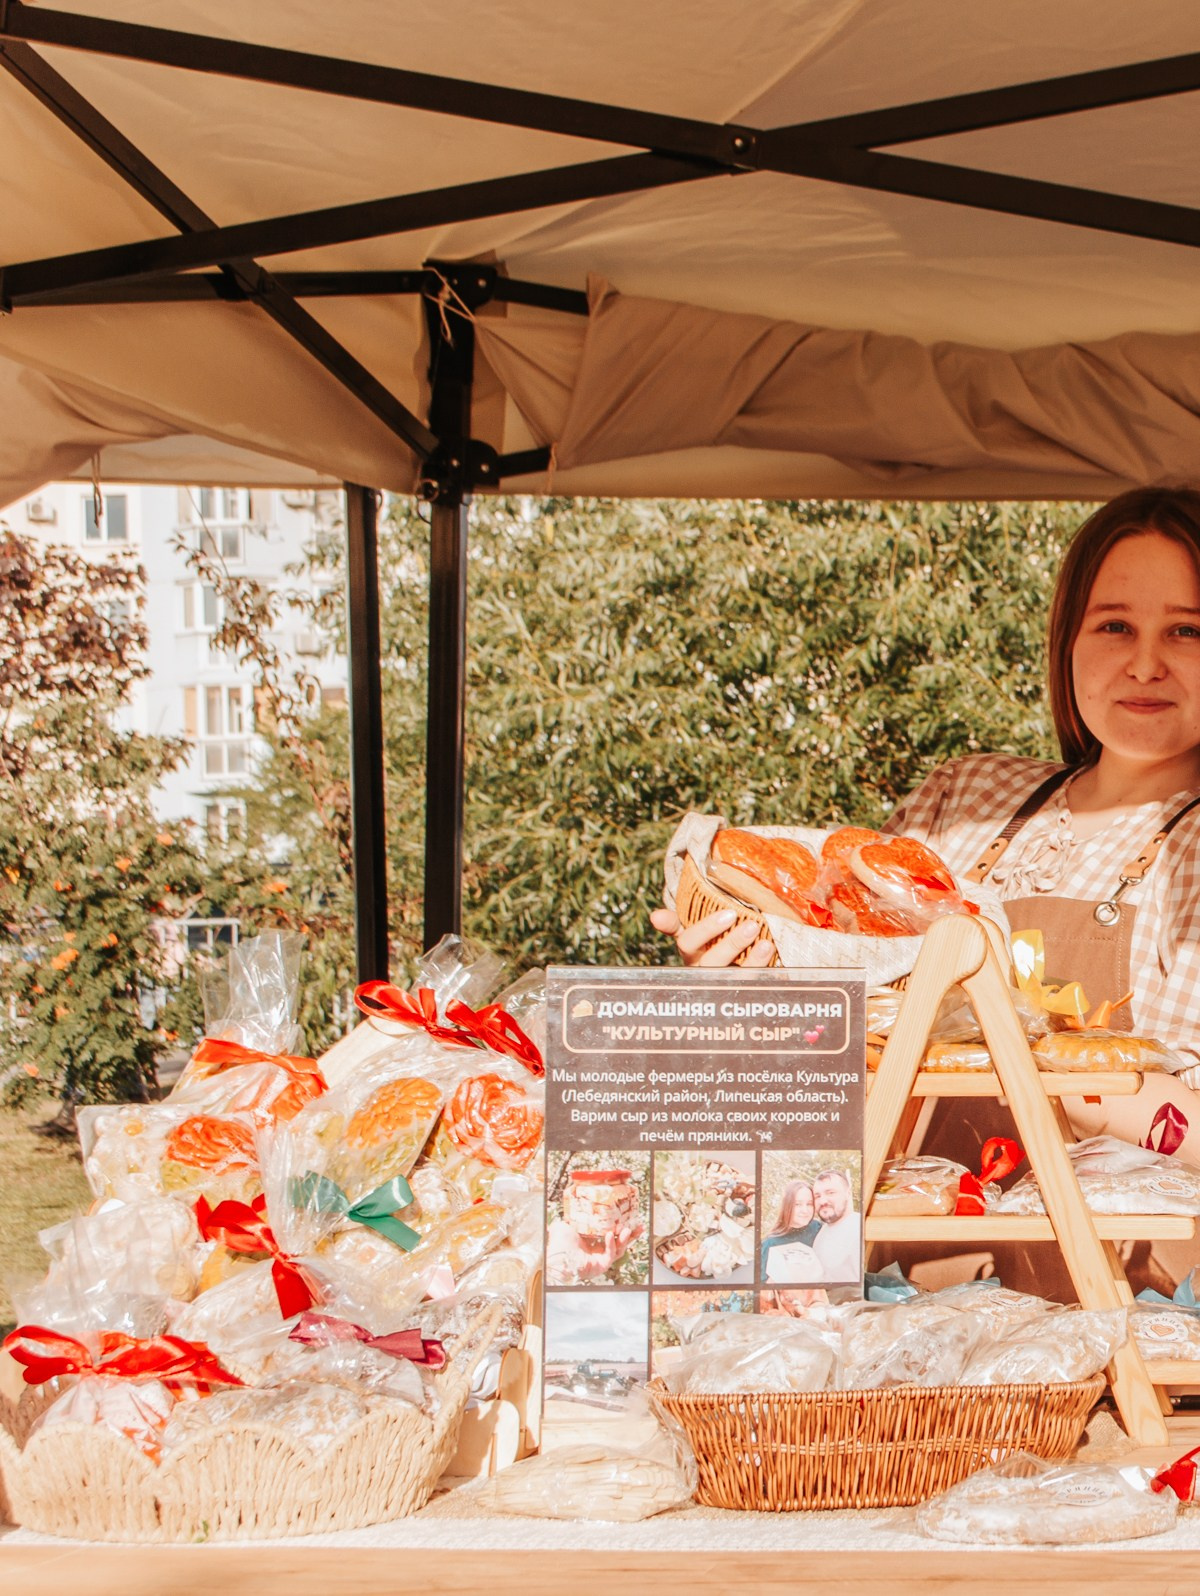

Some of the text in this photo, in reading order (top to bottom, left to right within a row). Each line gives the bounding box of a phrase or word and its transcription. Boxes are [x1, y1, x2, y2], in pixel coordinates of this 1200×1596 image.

[597, 1002, 842, 1019] ДОМАШНЯЯ СЫРОВАРНЯ
[602, 1023, 800, 1042] "КУЛЬТУРНЫЙ СЫР"
[552, 1069, 859, 1088] Мы молодые фермеры из посёлка Культура
[562, 1089, 849, 1105] (Лебедянский район, Липецкая область).
[571, 1109, 840, 1126] Варим сыр из молока своих коровок и
[639, 1129, 752, 1145] печём пряники.
